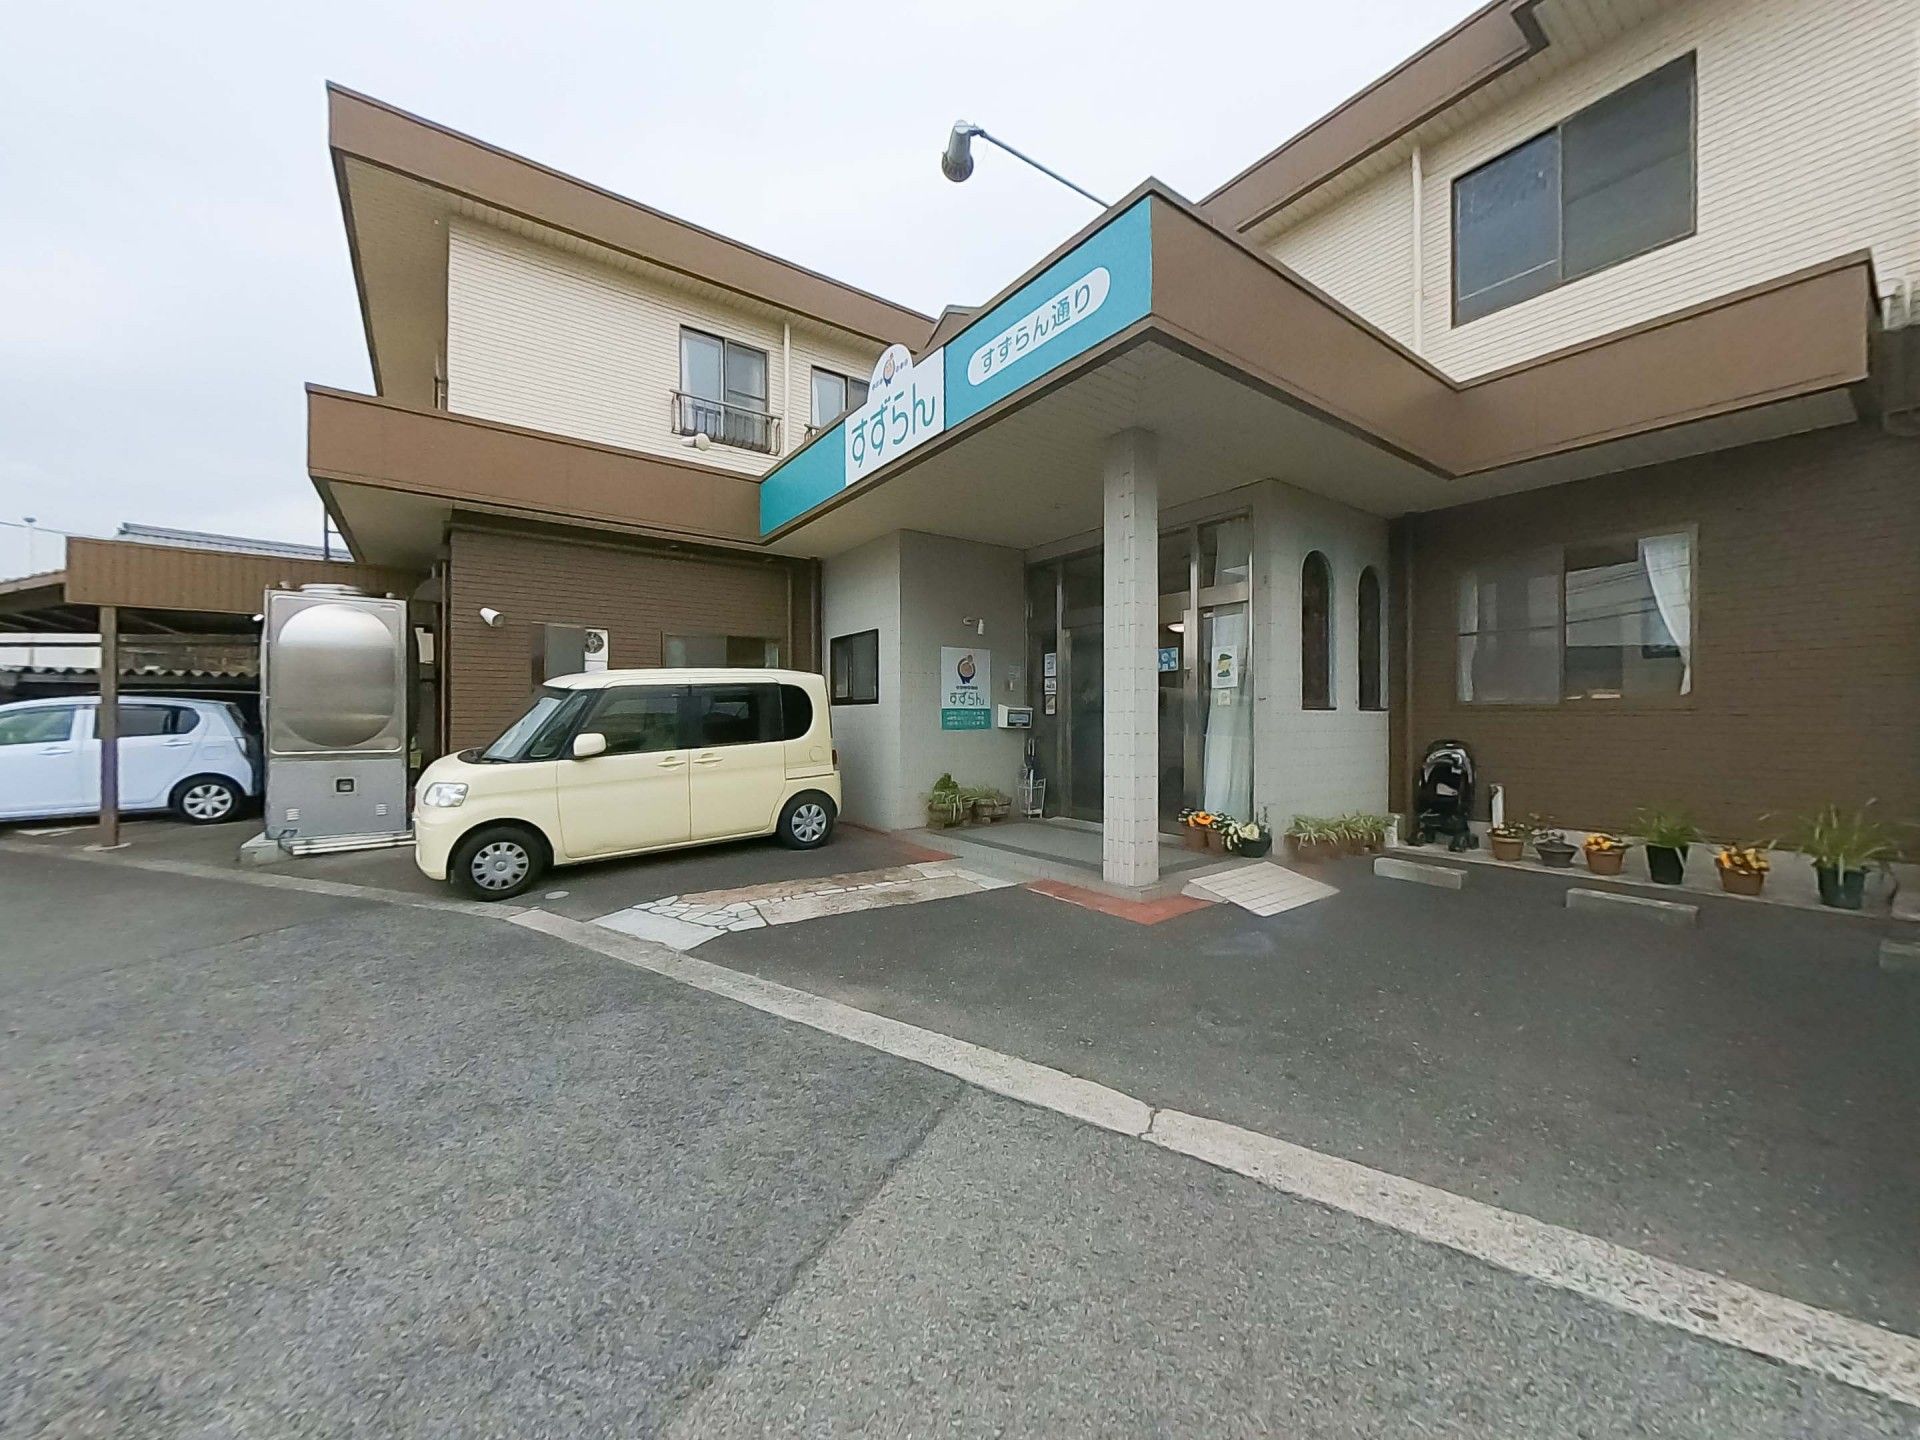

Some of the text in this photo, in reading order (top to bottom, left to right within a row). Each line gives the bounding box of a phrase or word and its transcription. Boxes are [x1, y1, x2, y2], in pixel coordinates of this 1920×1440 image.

[981, 284, 1090, 373] すずらん通り
[851, 382, 935, 468] すずらん
[949, 691, 985, 706] すずらん
